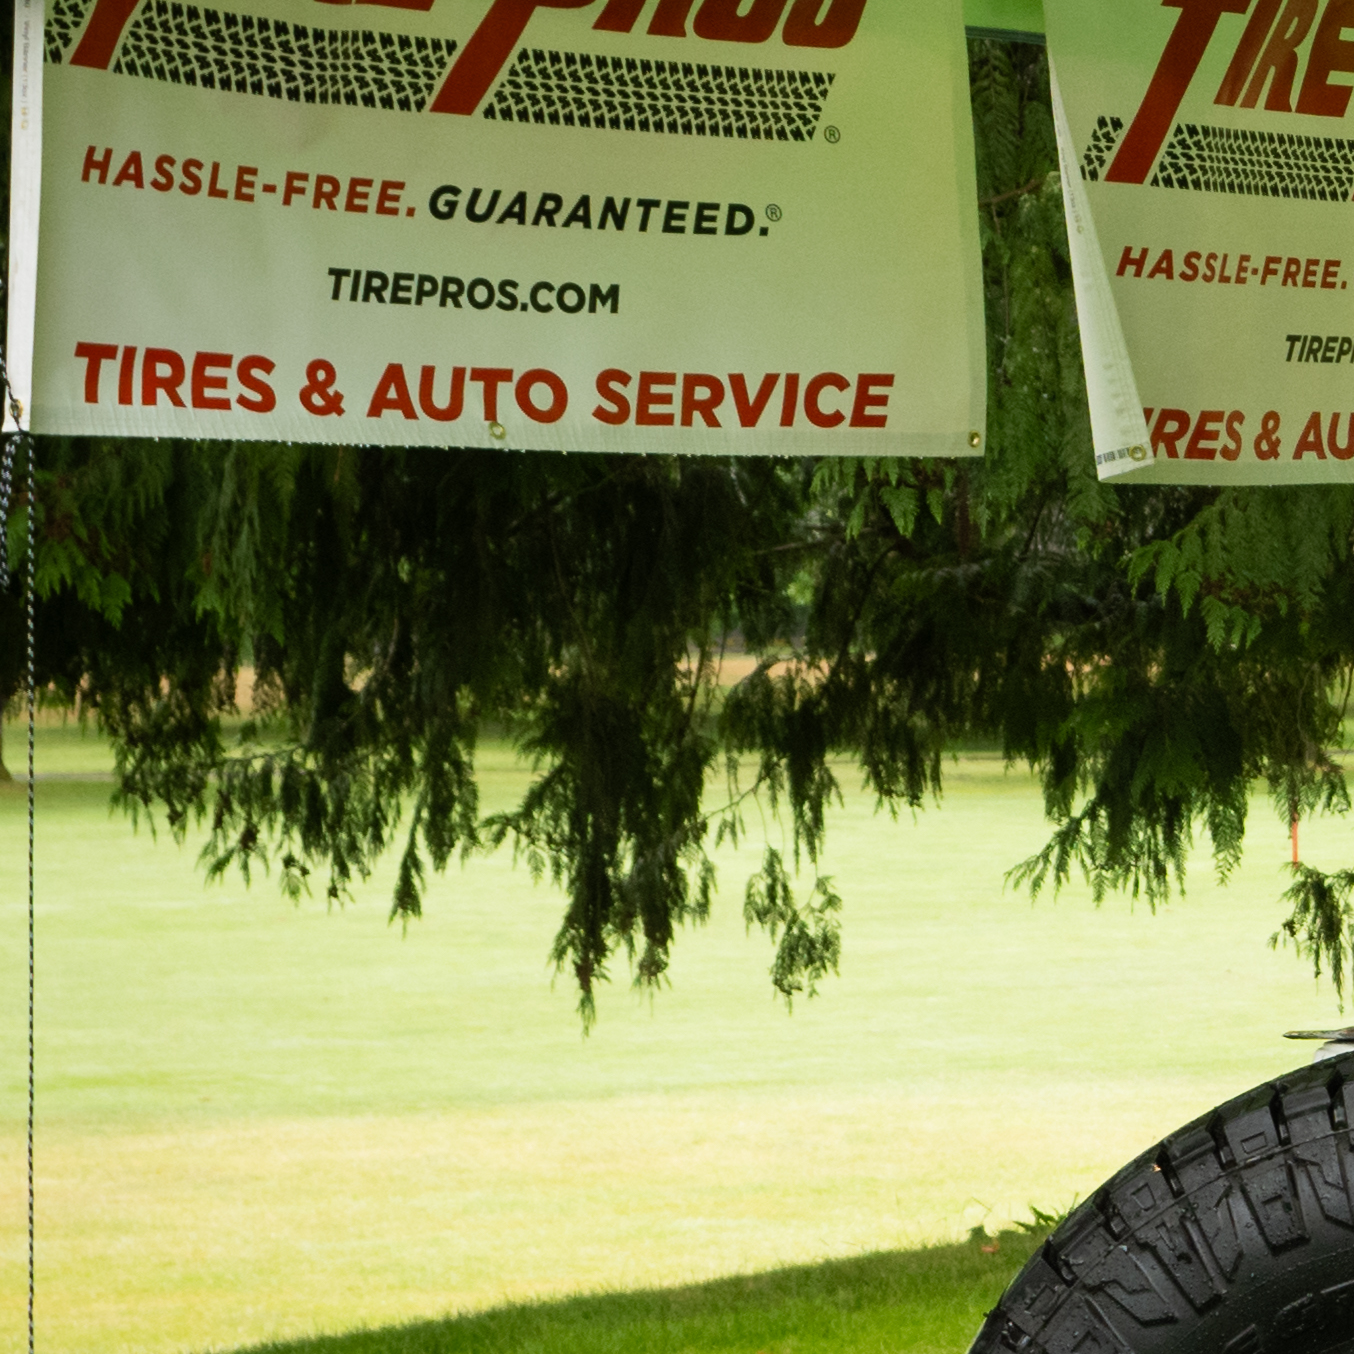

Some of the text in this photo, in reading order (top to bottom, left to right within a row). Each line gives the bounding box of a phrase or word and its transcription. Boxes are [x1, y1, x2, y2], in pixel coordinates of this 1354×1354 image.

[82, 147, 414, 216] HASSLE-FREE.
[328, 268, 619, 313] TIREPROS.COM
[1117, 247, 1347, 288] HASSLE-FREE.
[75, 343, 894, 428] TIRES & AUTO SERVICE
[1144, 409, 1244, 460] RES
[1255, 412, 1280, 460] &
